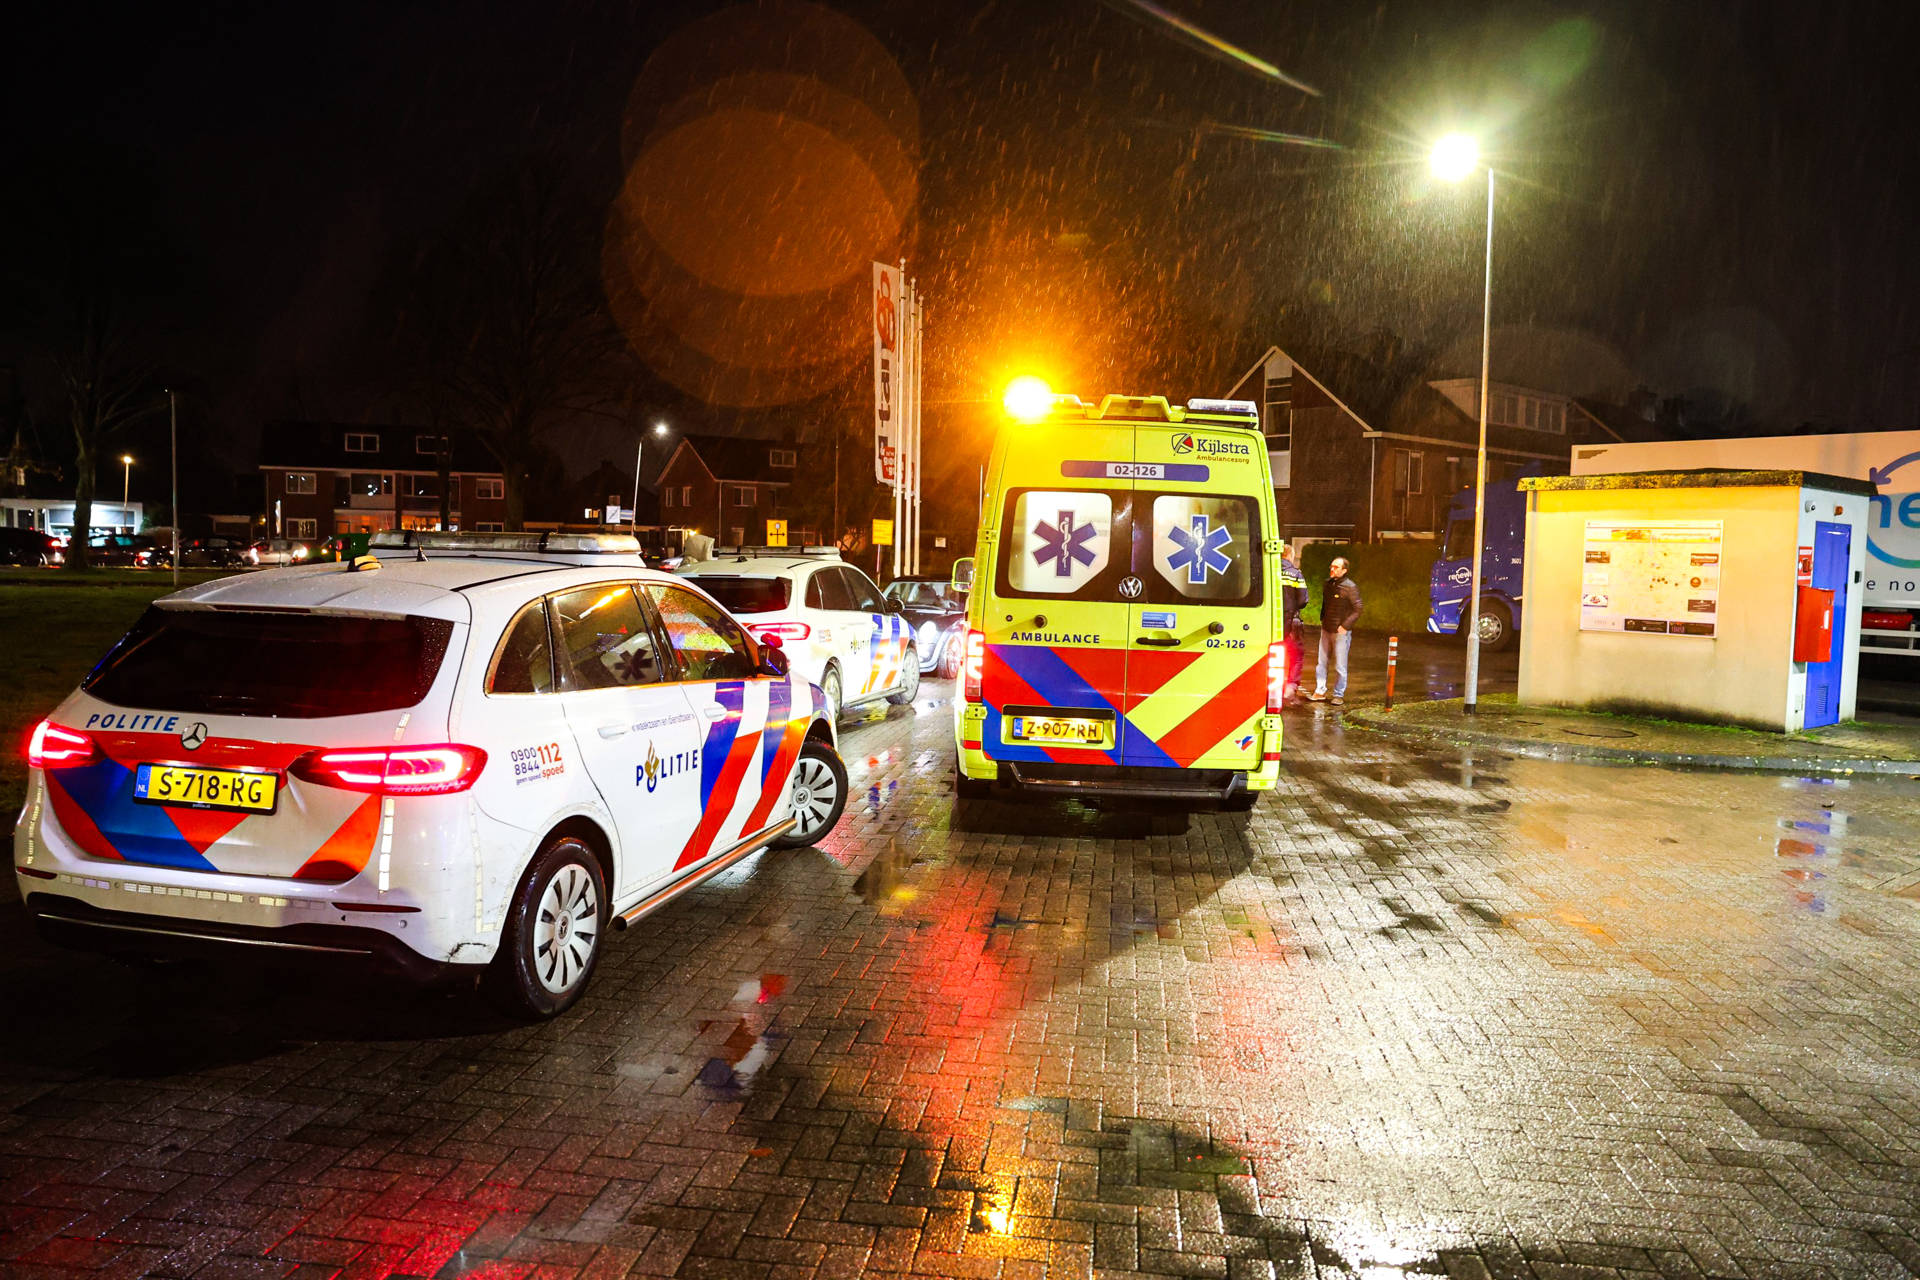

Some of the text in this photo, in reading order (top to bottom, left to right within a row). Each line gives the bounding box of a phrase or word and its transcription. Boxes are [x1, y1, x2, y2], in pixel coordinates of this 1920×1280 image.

[1197, 439, 1249, 455] Kijlstra
[1114, 465, 1157, 476] 02-126
[1010, 631, 1101, 644] AMBULANCE
[1206, 639, 1246, 649] 02-126
[85, 713, 179, 732] POLITIE
[1027, 721, 1097, 738] Z-907-RH
[511, 743, 562, 764] 0900 112
[514, 760, 540, 776] 8844
[542, 764, 564, 780] spoed
[636, 749, 698, 793] POLITIE
[158, 769, 262, 803] S-718-RG
